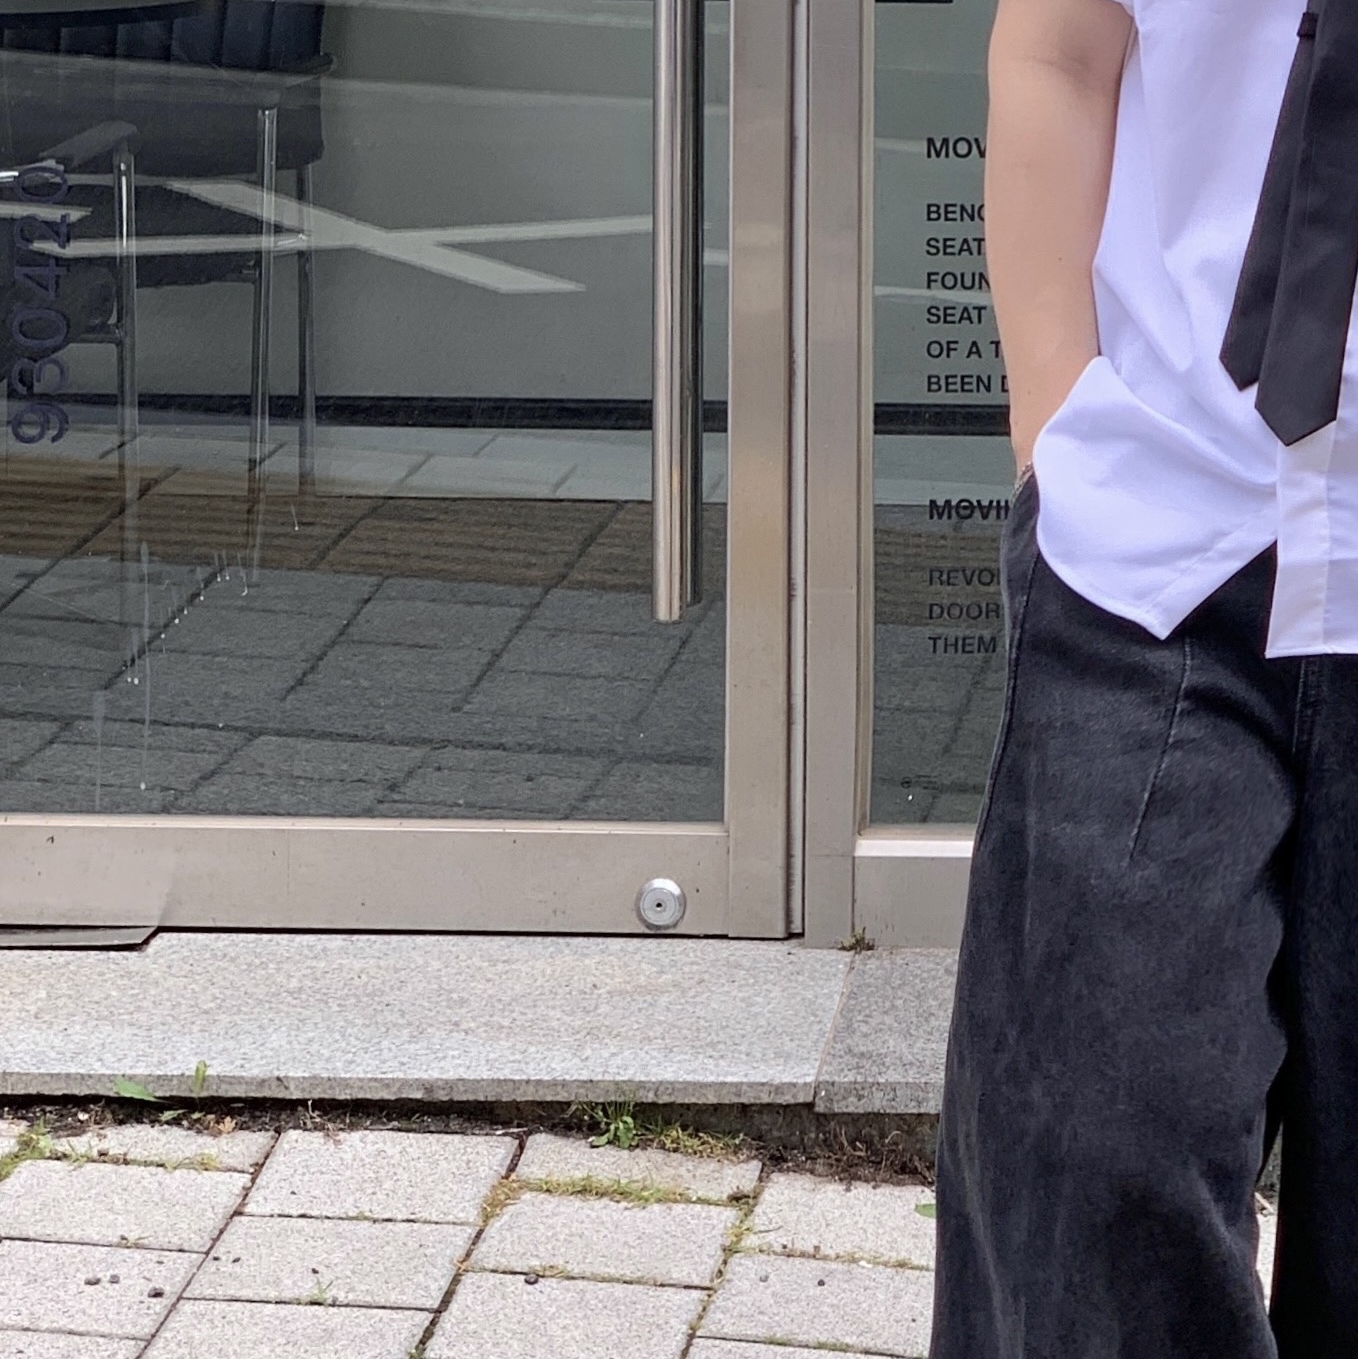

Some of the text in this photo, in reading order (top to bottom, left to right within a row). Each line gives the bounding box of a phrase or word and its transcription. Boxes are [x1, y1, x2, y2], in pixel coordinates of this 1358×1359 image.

[10, 166, 71, 444] 930420
[926, 305, 987, 324] SEAT
[926, 340, 959, 359] OF
[966, 340, 982, 358] A
[927, 374, 991, 393] BEEN
[928, 636, 997, 654] THEM
